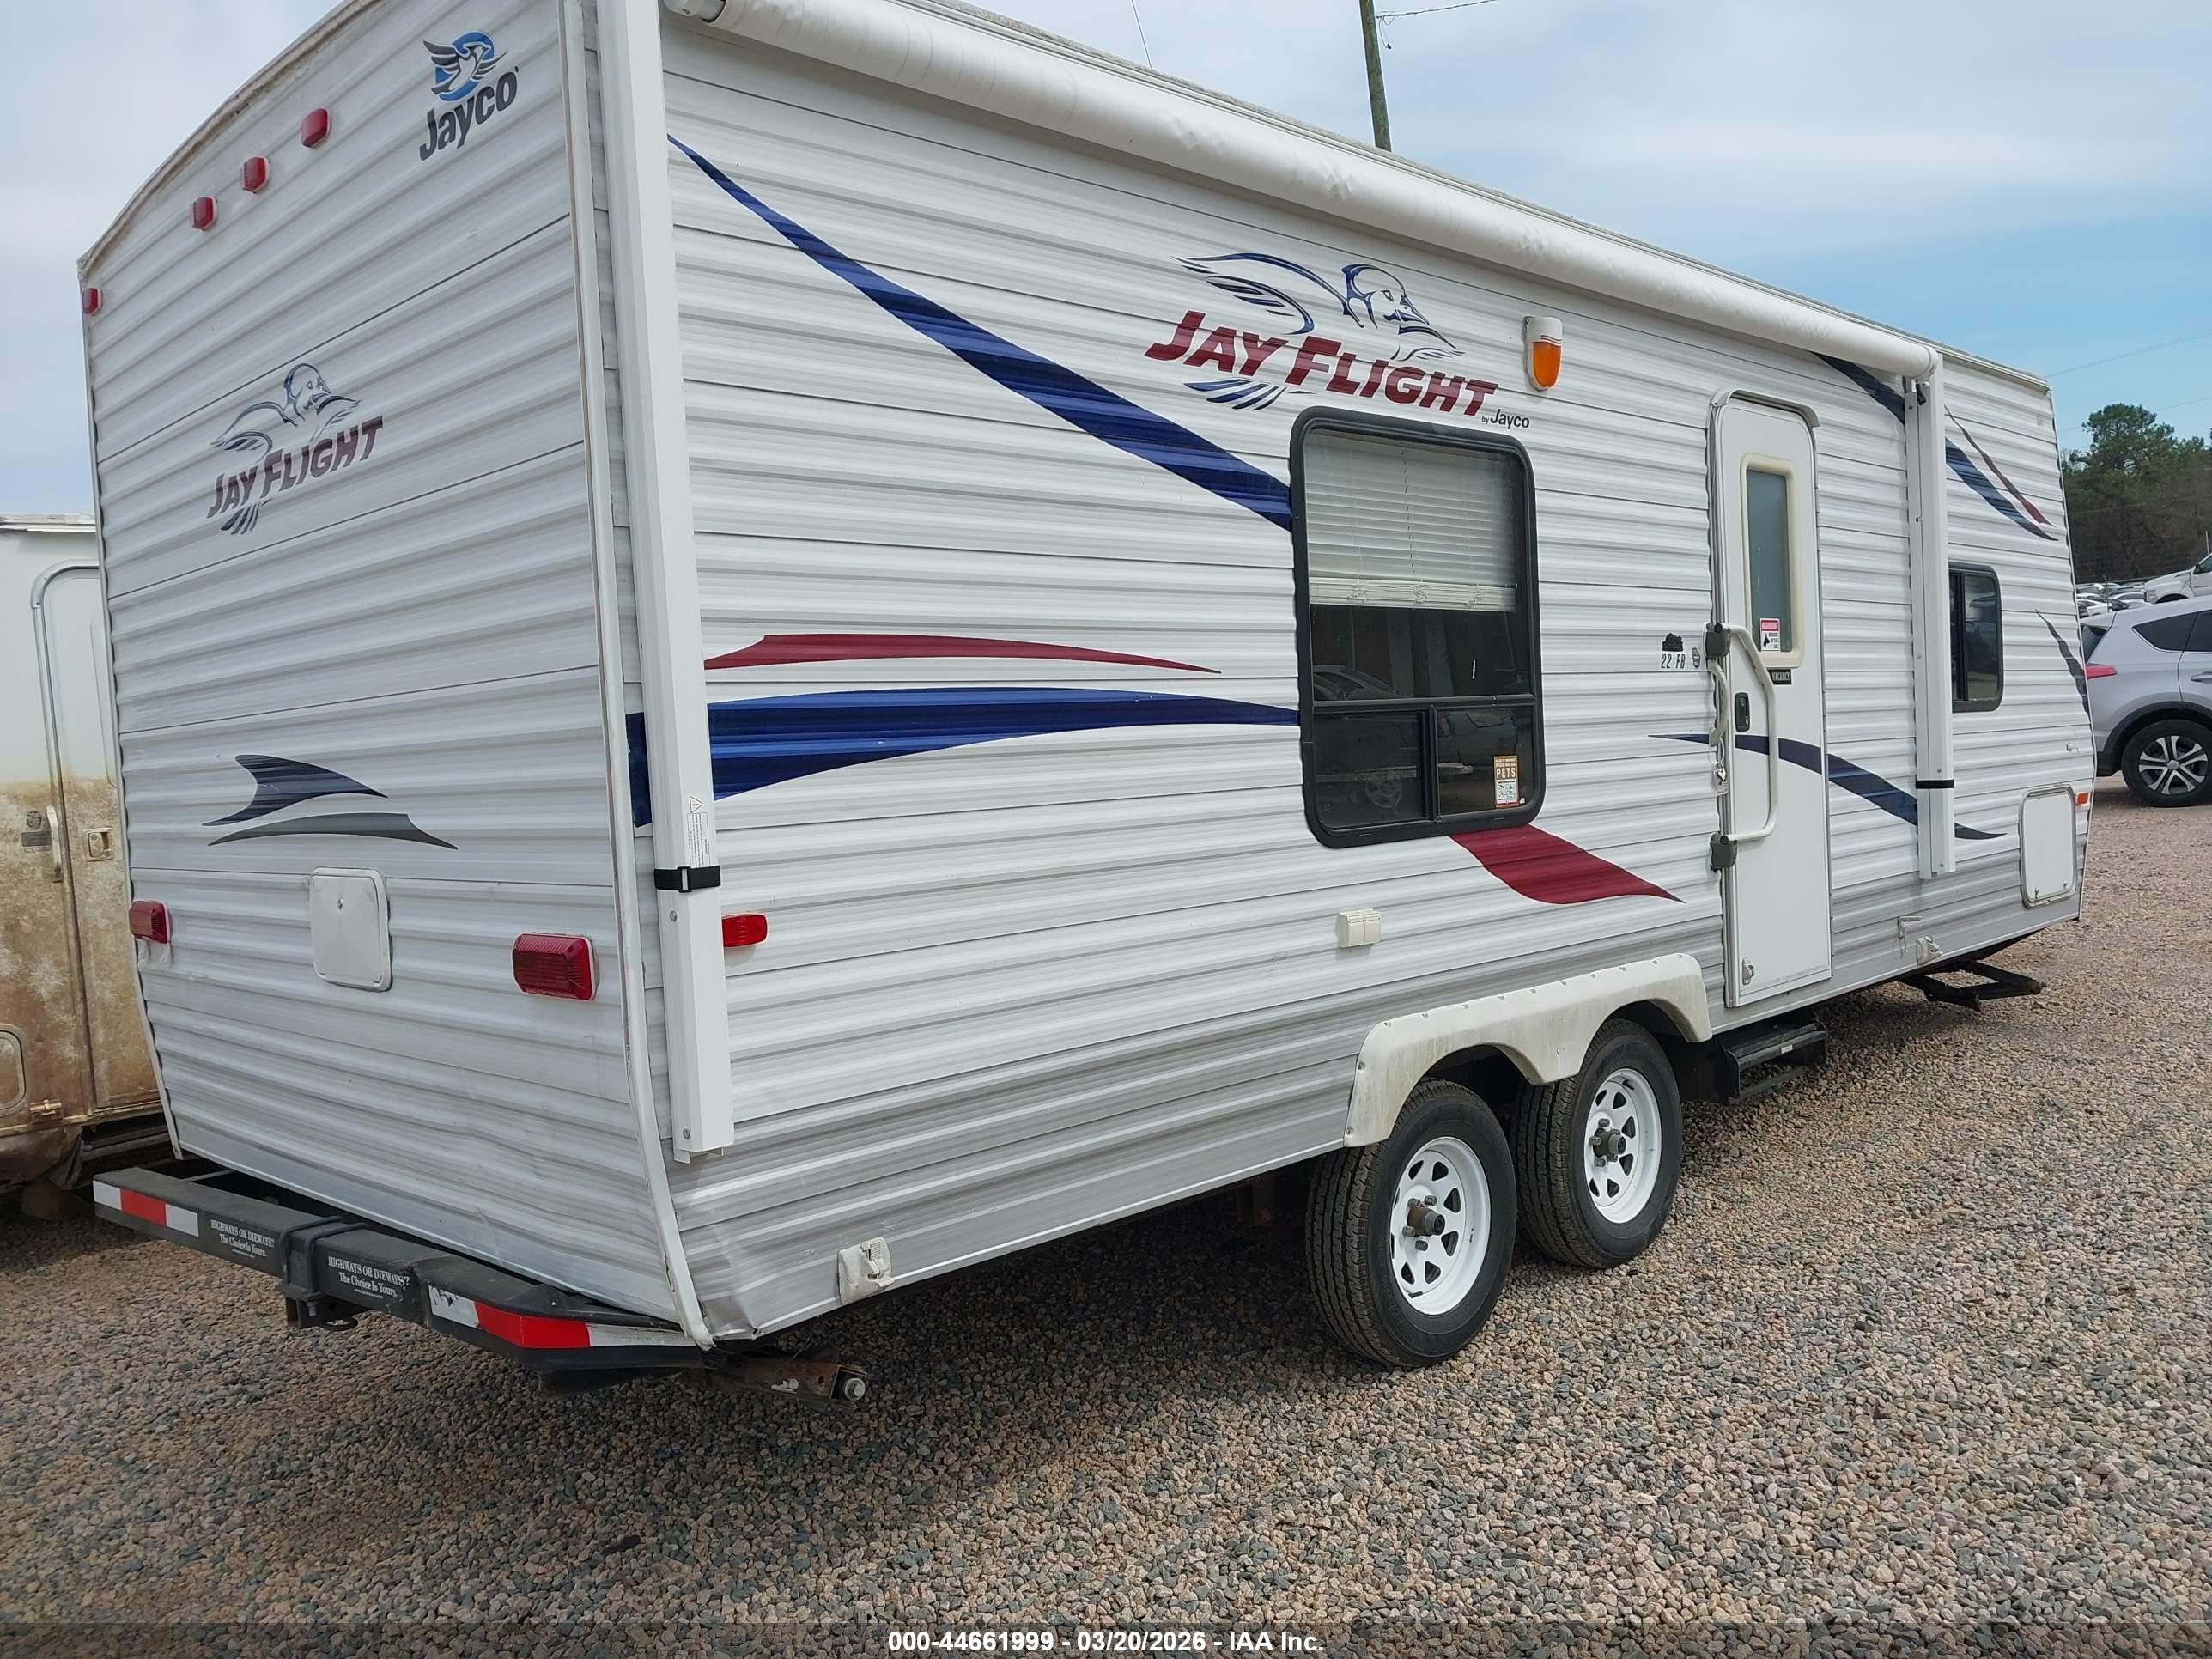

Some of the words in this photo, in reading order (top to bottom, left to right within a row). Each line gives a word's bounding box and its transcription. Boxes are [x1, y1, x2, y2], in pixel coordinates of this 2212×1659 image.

[419, 71, 518, 161] Jayco
[1144, 310, 1289, 377] JAY
[1285, 336, 1499, 417] FLIGHT
[1481, 416, 1490, 425] by
[1489, 408, 1531, 430] Jayco
[206, 465, 258, 519] JAY
[259, 415, 385, 499] FLIGHT
[1661, 653, 1672, 669] 22
[1675, 653, 1686, 669] FB
[1496, 767, 1516, 779] PETS
[210, 1219, 239, 1237] HIGHWAYS
[239, 1228, 247, 1239] OR
[247, 1231, 275, 1248] DIEWAYS?
[219, 1233, 229, 1244] The
[228, 1237, 246, 1250] Choice
[328, 1256, 362, 1274] HIGHWAYS
[362, 1265, 373, 1277] OR
[373, 1268, 410, 1286] DIEWAYS?
[338, 1272, 350, 1284] The
[350, 1275, 371, 1288] Choice
[371, 1280, 378, 1291] Is
